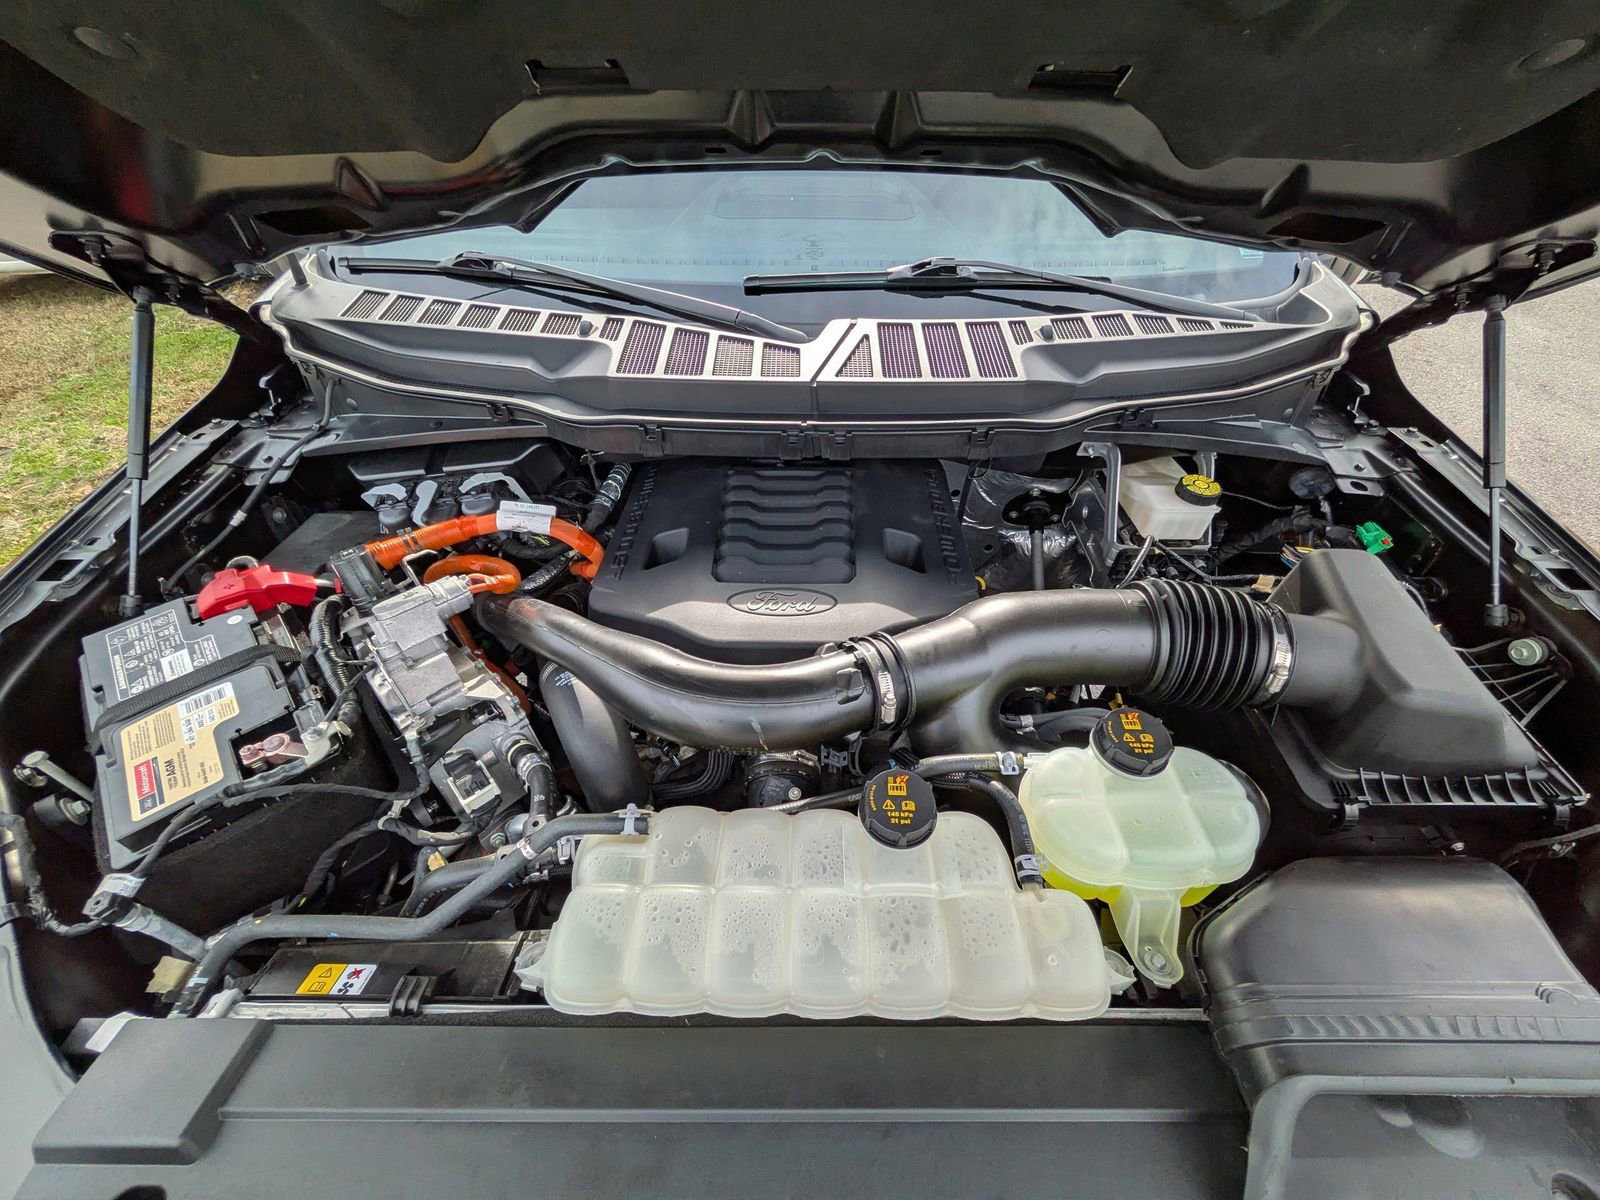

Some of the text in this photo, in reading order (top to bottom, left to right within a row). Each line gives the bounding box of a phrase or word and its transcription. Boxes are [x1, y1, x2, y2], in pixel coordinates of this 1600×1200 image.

[746, 591, 818, 612] Ford
[164, 758, 177, 777] AGM
[138, 763, 151, 795] Motorcraft
